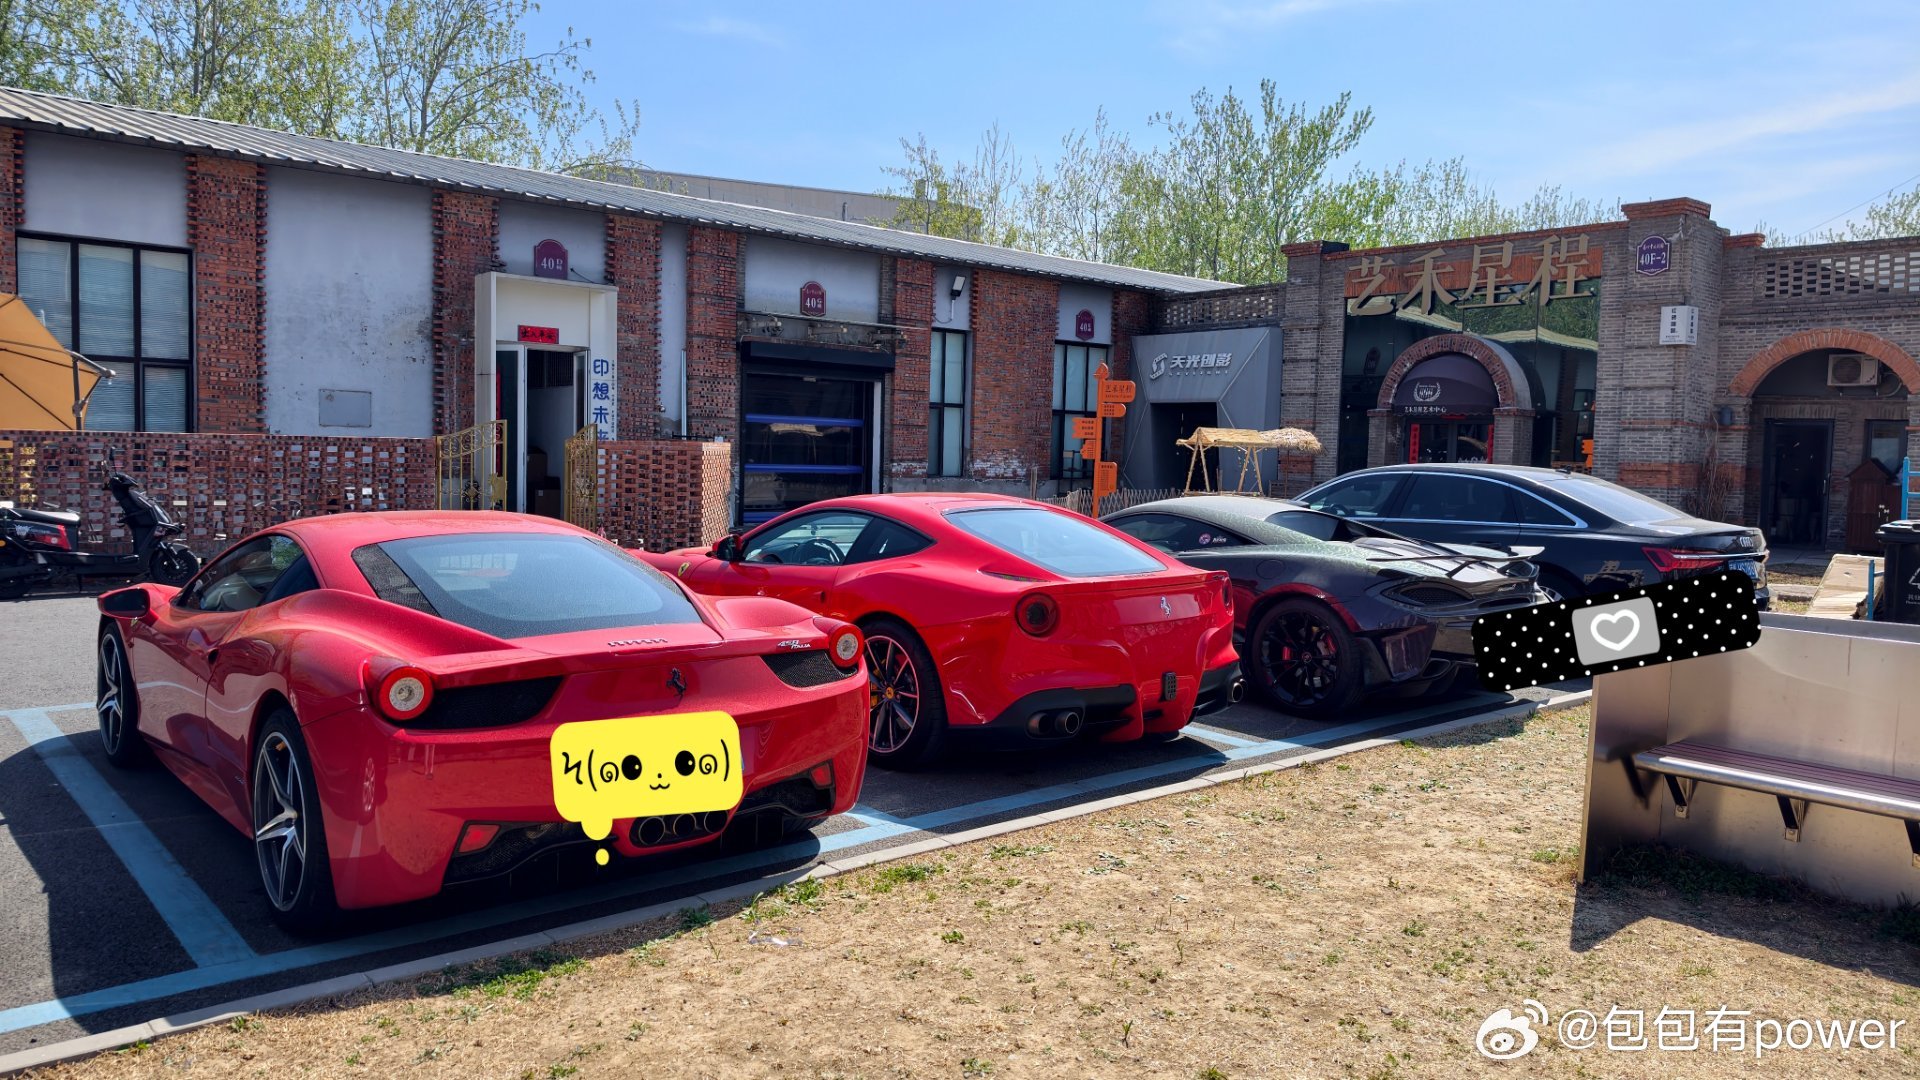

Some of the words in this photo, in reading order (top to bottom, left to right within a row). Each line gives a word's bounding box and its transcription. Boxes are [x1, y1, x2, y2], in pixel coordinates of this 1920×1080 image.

[1639, 251, 1666, 265] 40F-2
[1348, 233, 1596, 316] 艺禾星程
[1169, 352, 1233, 369] 天光创影
